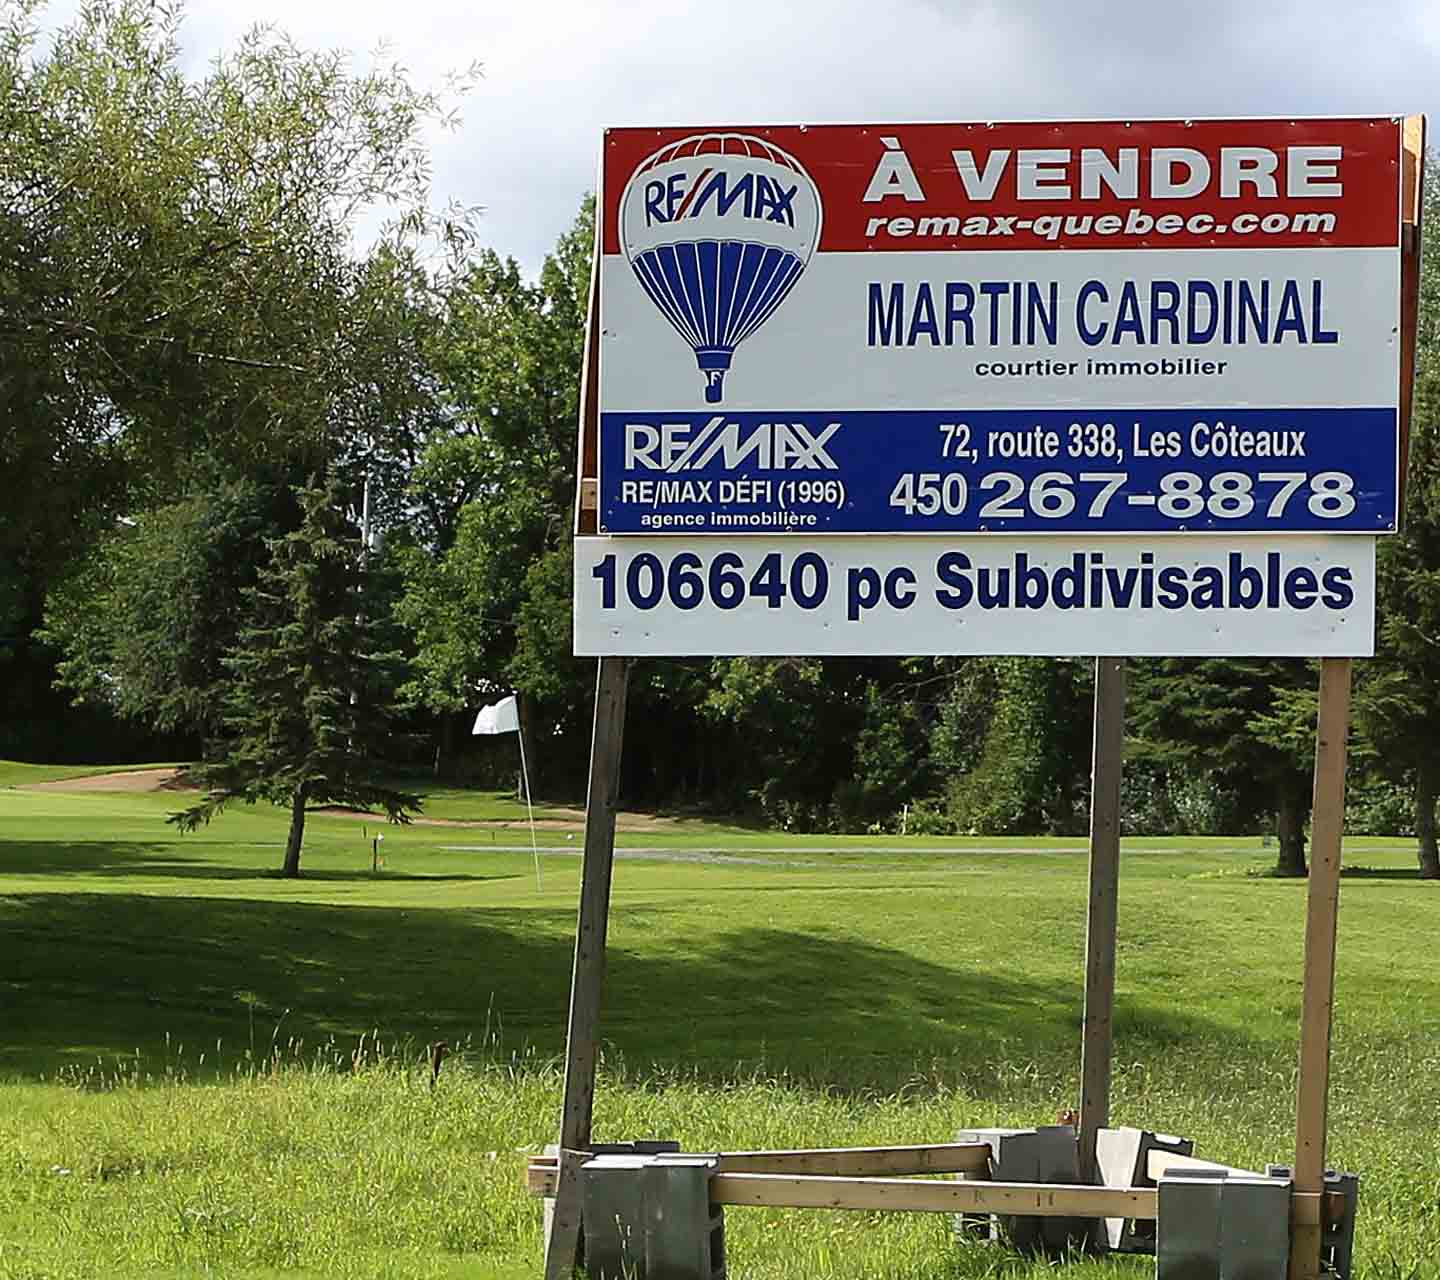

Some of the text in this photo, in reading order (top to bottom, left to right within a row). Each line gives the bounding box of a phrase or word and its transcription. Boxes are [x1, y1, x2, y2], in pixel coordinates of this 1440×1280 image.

[863, 137, 1343, 202] À VENDRE
[645, 166, 797, 228] RE/MAX
[866, 209, 1336, 240] remax-quebec.com
[867, 280, 1339, 347] MARTIN CARDINAL
[975, 357, 1228, 377] courtier immobilier
[625, 416, 841, 474] RE/MAX
[940, 422, 1306, 463] 72, route 338, Les Côteaux
[621, 475, 846, 508] RE/MAX DÉFI (1996)
[889, 471, 1356, 518] 450 267-8878
[641, 509, 817, 528] agence immobilière
[591, 552, 1355, 621] 106640 pc Subdivisables
